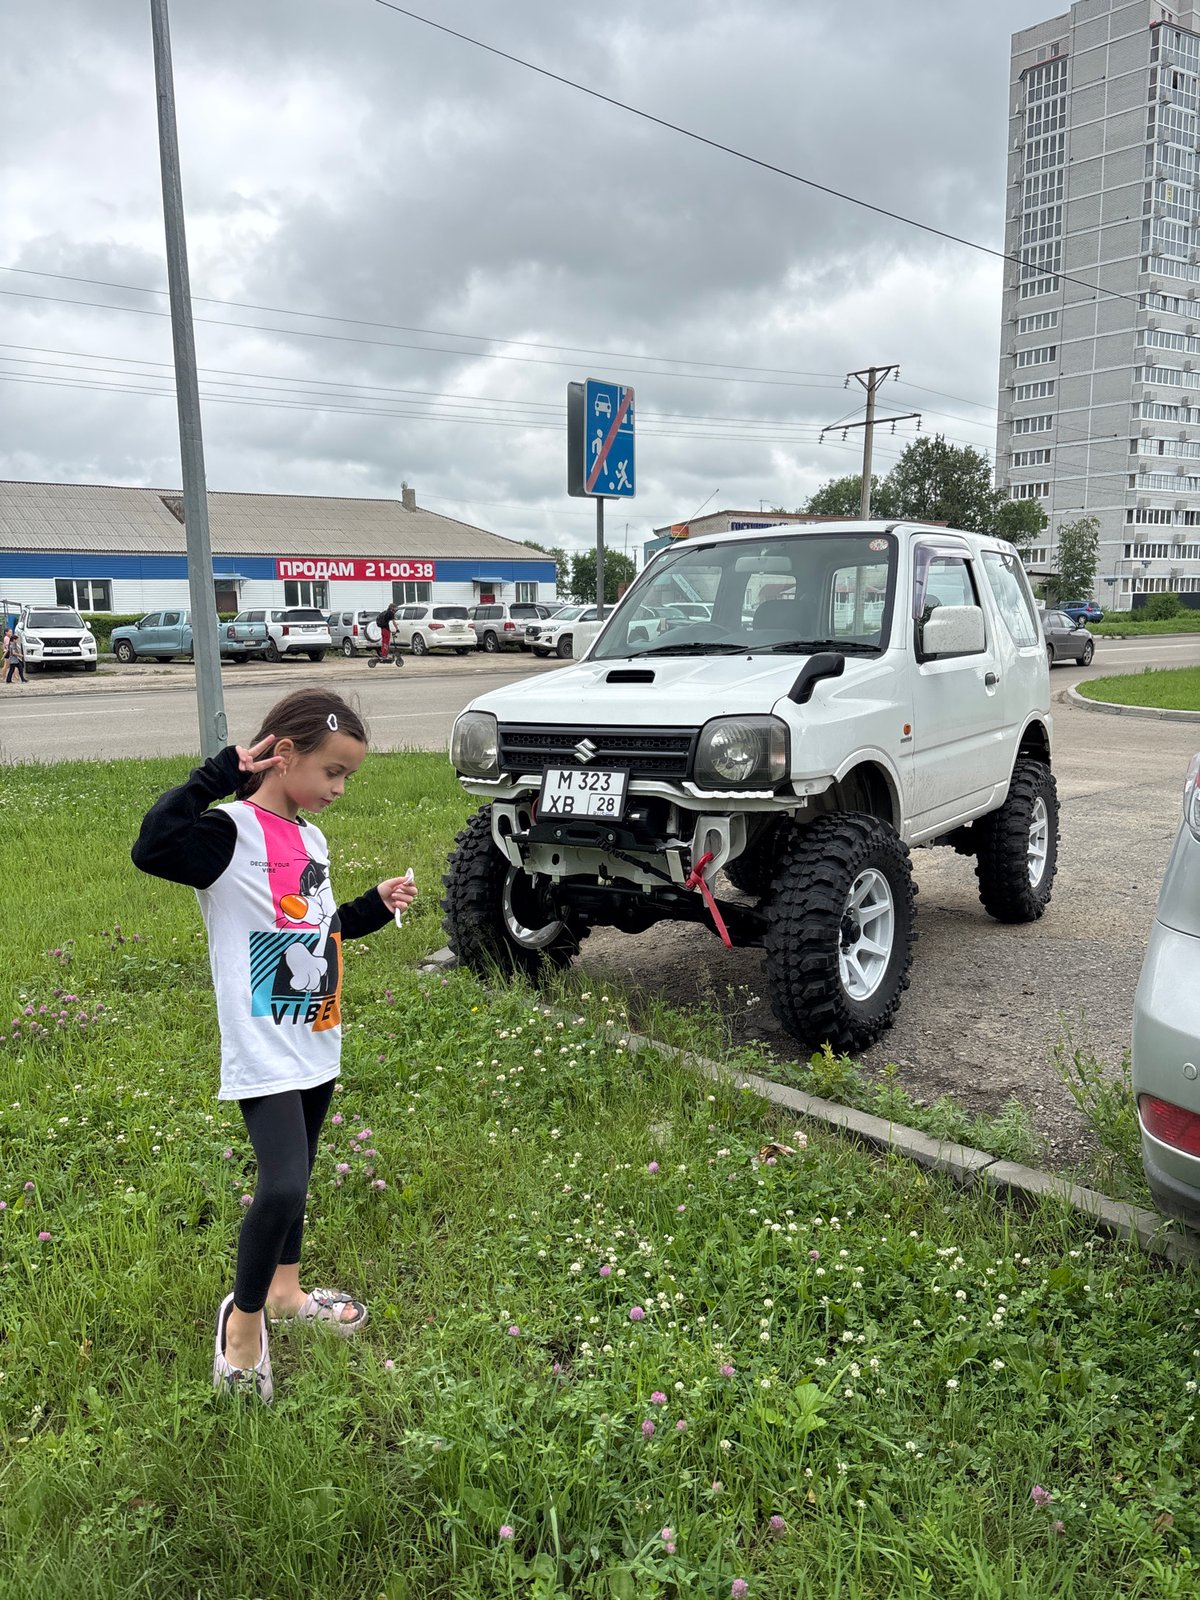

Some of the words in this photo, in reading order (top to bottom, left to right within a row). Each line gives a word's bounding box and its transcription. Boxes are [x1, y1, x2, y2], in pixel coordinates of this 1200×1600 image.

[279, 561, 355, 579] ПРОДАМ
[365, 562, 433, 578] 21-00-38
[578, 772, 612, 791] 323
[597, 797, 615, 812] 28
[271, 1000, 335, 1025] VIBE
